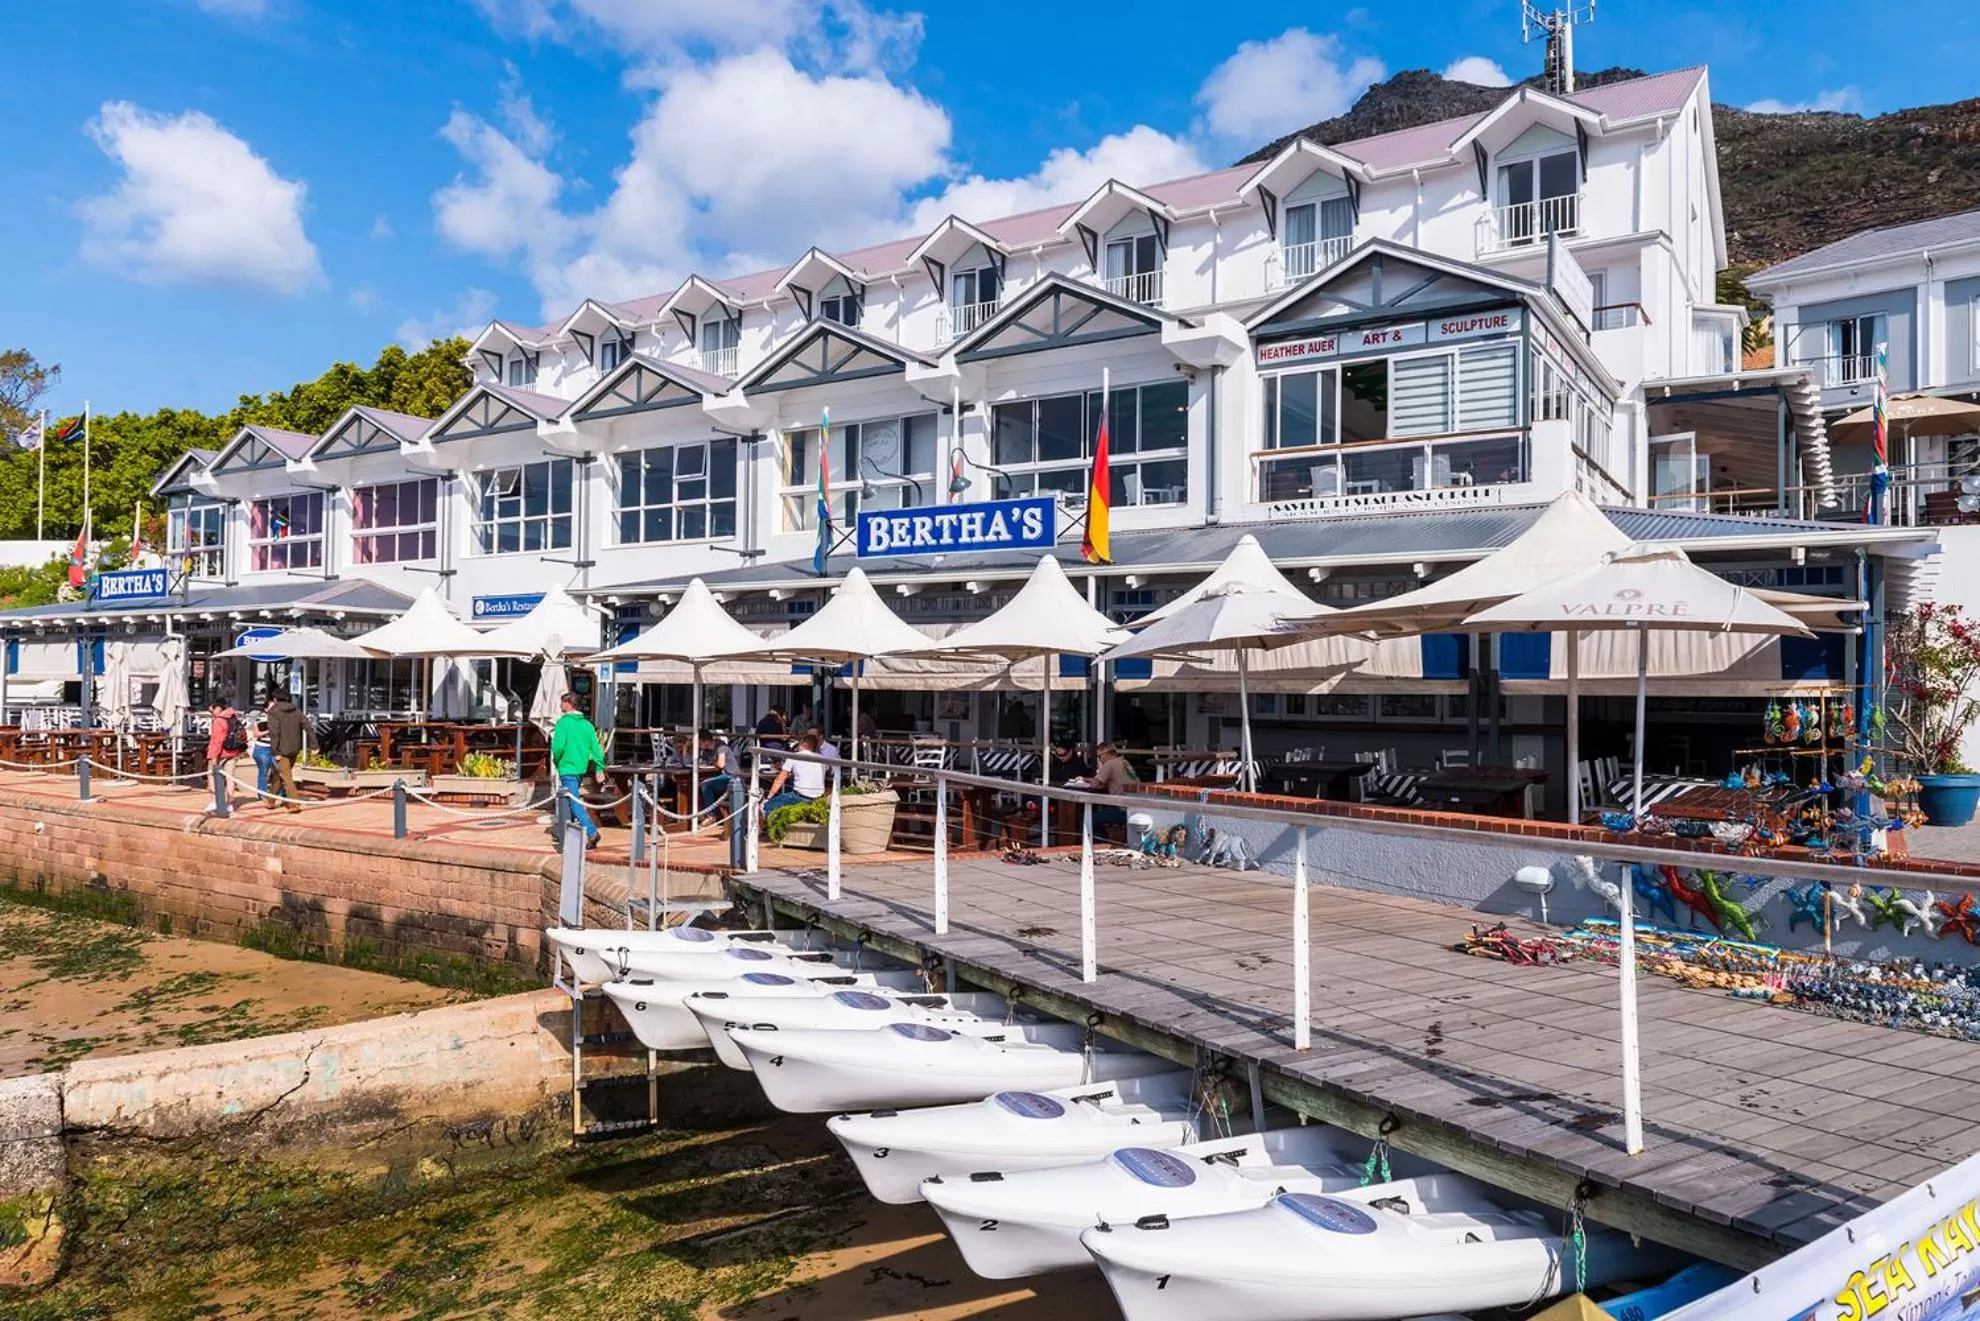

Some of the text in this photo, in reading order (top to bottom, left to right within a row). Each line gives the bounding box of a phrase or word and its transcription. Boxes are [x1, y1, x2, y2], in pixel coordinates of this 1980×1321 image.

[1441, 315, 1508, 335] SCULPTURE
[1363, 329, 1402, 346] ART &
[1260, 341, 1335, 361] HEATHER AUER
[867, 507, 1043, 552] BERTHA'S
[101, 574, 164, 597] BERTHA'S
[485, 601, 511, 613] Bertha's
[575, 947, 585, 955] 8
[634, 1001, 647, 1011] 6
[723, 1021, 736, 1032] 5
[769, 1055, 783, 1067] 4
[873, 1147, 890, 1158] 3
[979, 1219, 999, 1231] 2
[1155, 1274, 1171, 1290] 1
[1835, 1241, 1916, 1321] SEA
